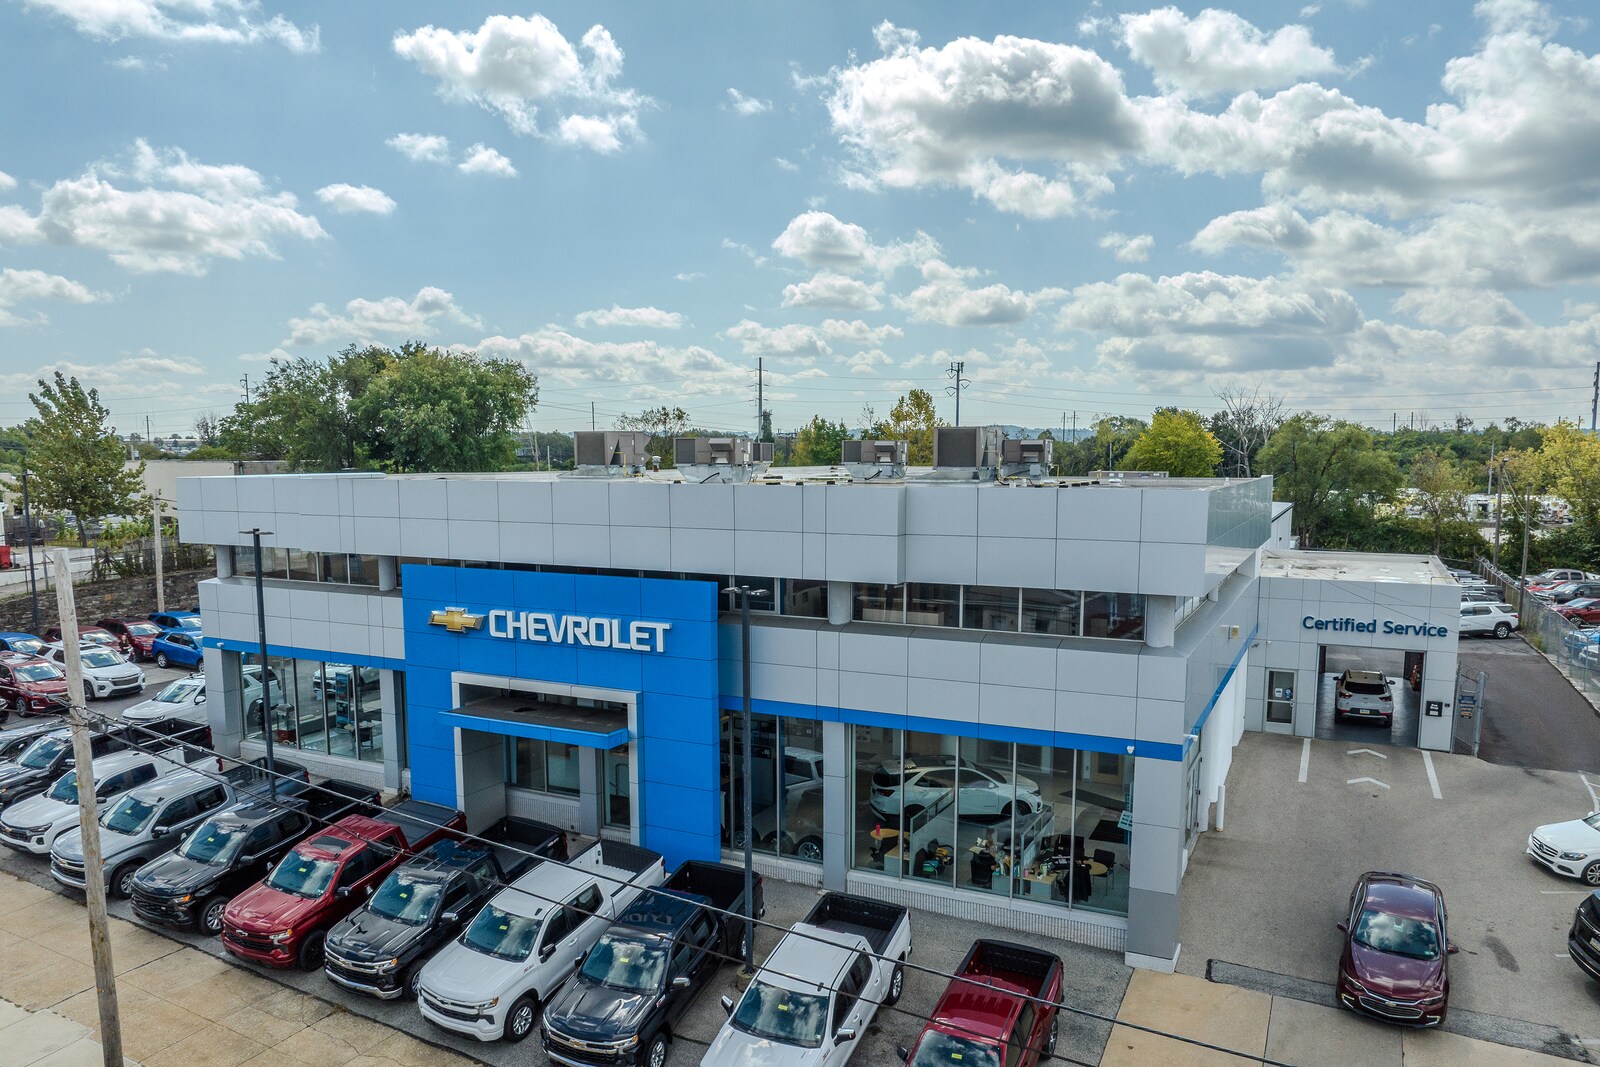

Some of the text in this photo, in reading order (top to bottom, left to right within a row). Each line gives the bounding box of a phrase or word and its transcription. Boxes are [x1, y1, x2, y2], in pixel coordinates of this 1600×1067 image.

[489, 609, 672, 652] CHEVROLET
[1302, 616, 1449, 638] Certified Service
